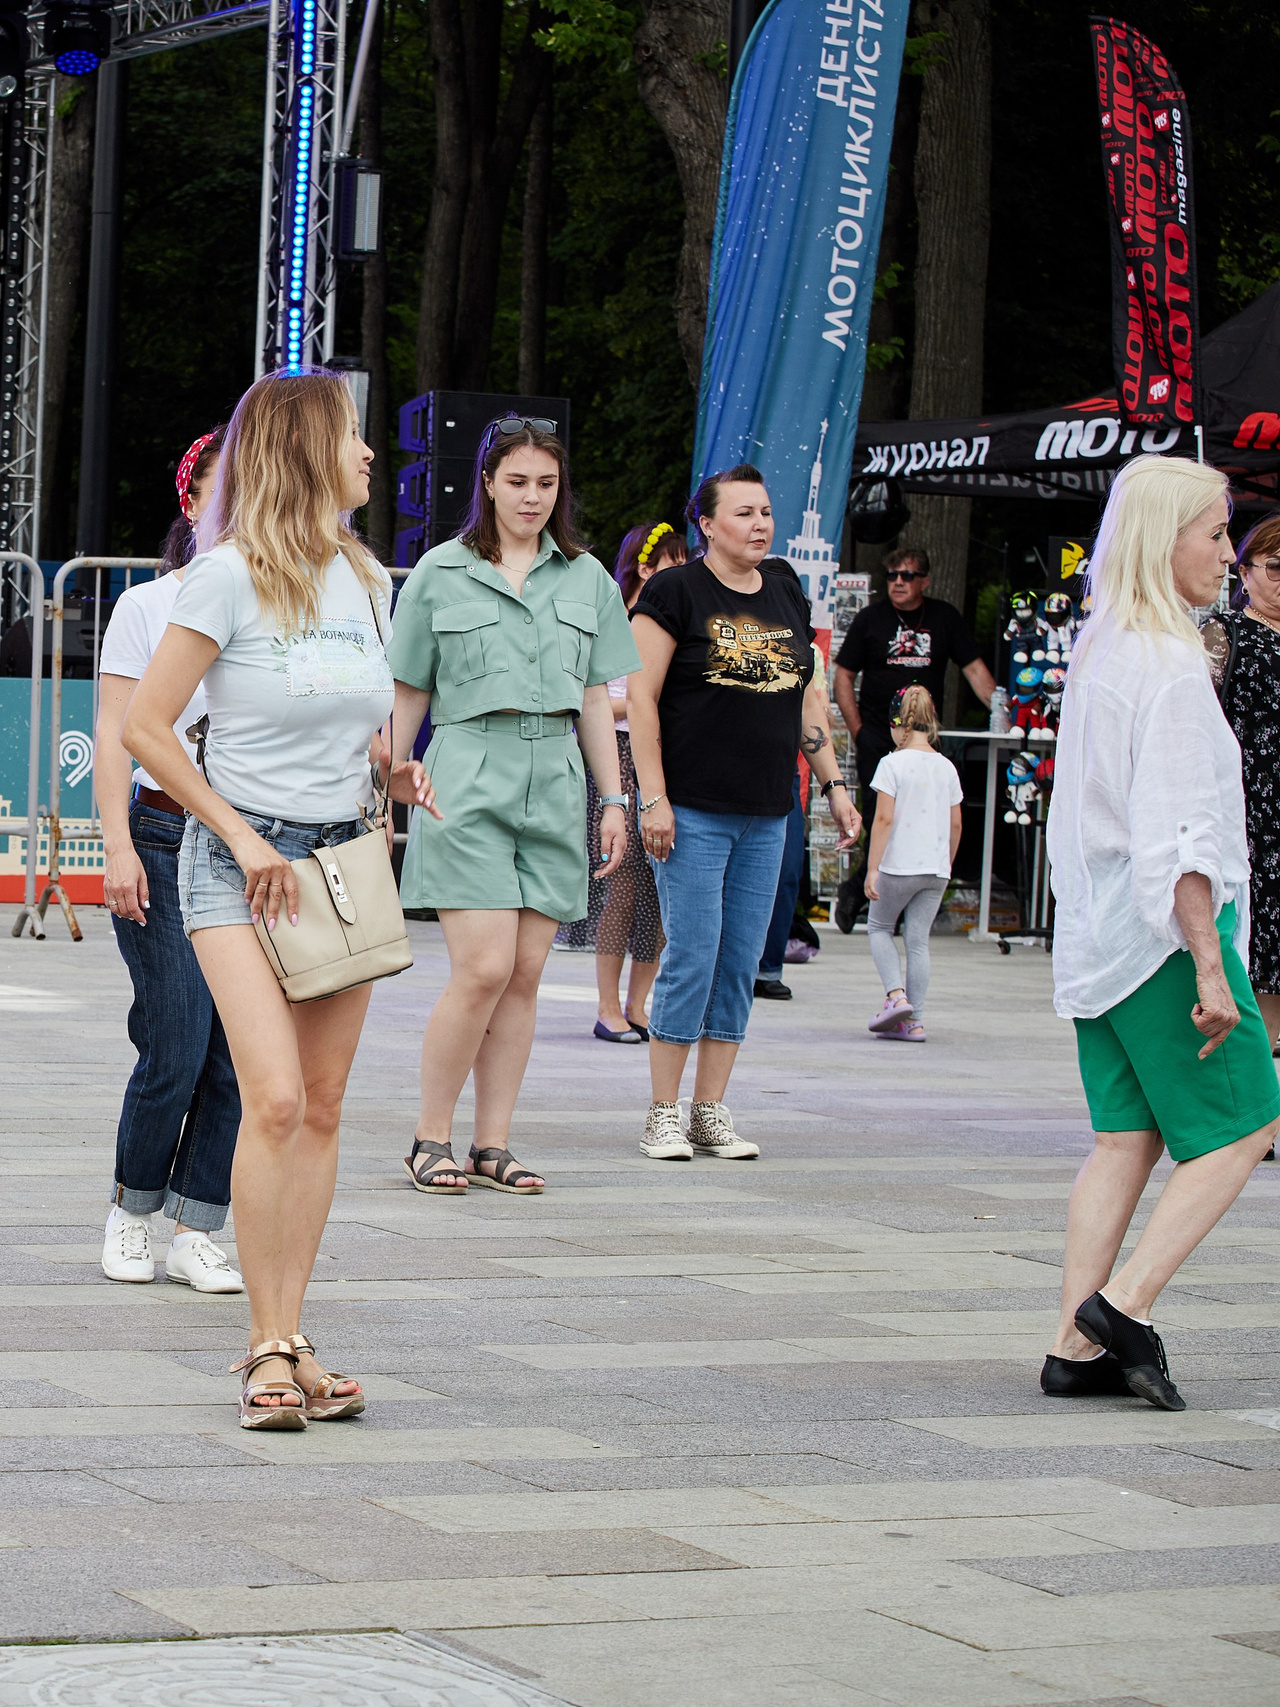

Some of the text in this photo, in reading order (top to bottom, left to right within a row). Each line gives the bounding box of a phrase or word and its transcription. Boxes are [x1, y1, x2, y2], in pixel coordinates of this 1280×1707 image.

[816, 0, 854, 107] ДЕНЬ
[1124, 152, 1135, 215] MOTO
[1135, 101, 1156, 245] MOTO
[1172, 108, 1187, 225] magazine
[1123, 294, 1144, 411] MOTO
[1164, 222, 1194, 422] MOTO
[861, 436, 991, 478] журнал
